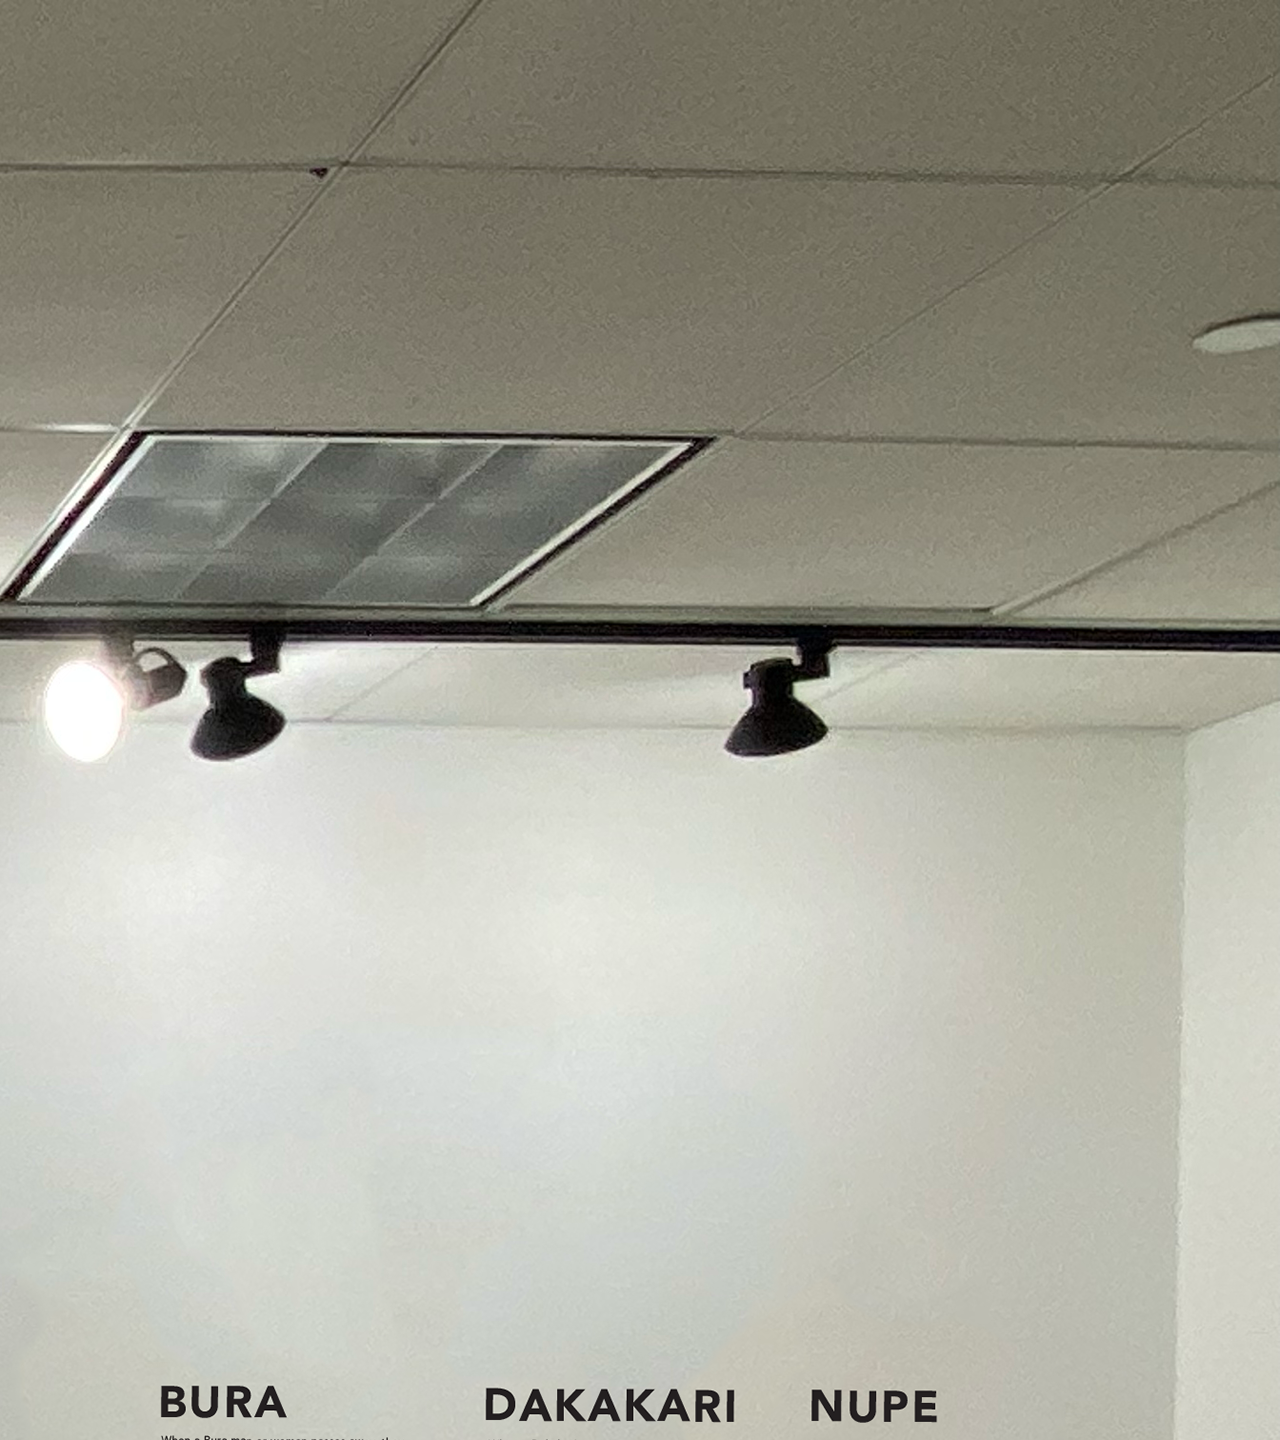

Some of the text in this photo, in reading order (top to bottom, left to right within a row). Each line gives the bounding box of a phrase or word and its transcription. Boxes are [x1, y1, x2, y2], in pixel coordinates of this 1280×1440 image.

[160, 1385, 287, 1419] BURA
[485, 1387, 735, 1423] DAKAKARI
[811, 1389, 937, 1423] NUPE
